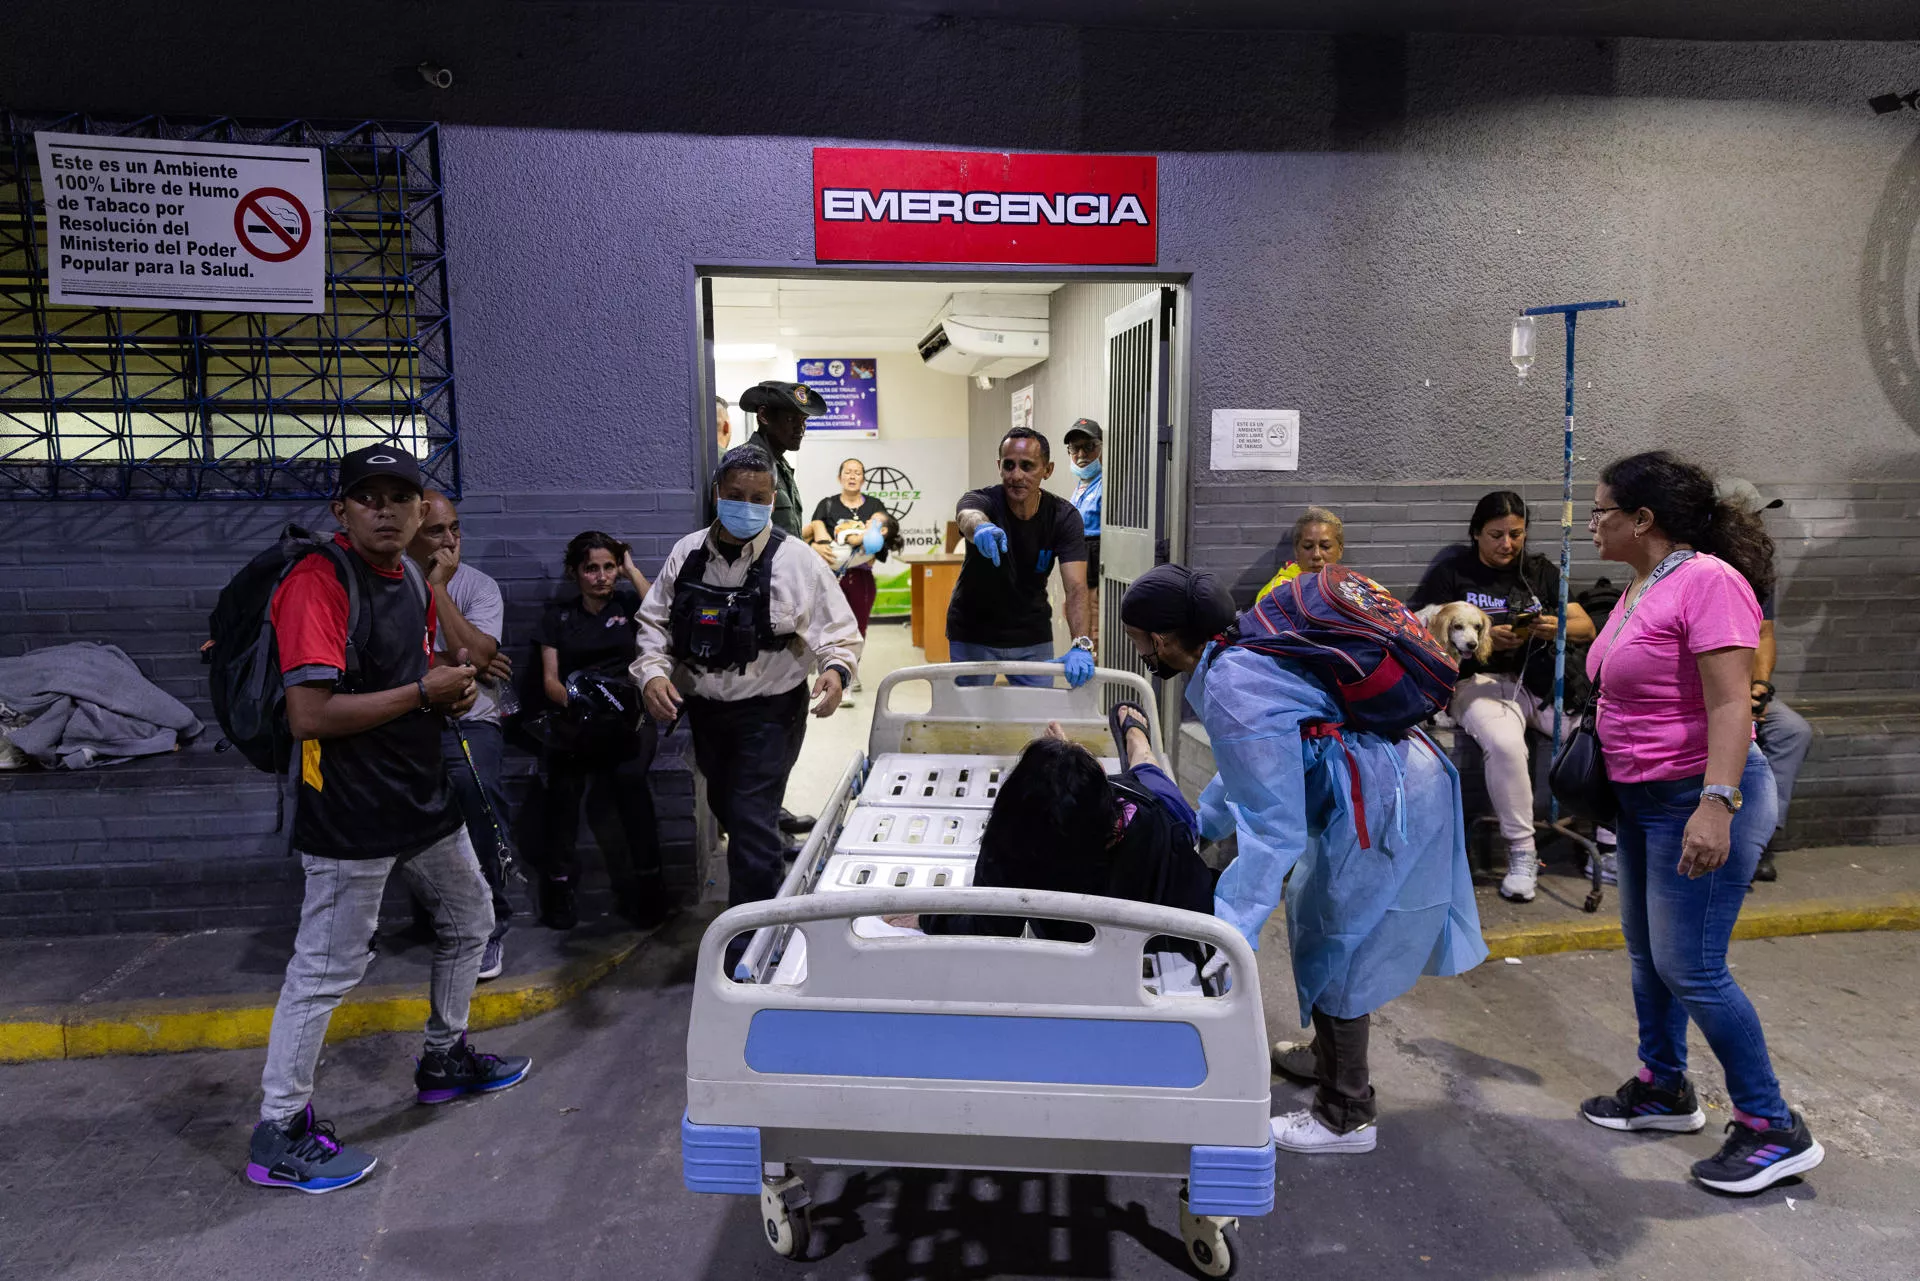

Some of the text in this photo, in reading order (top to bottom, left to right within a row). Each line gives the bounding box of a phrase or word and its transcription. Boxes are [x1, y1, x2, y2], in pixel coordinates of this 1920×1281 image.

[52, 153, 238, 179] Este es un Ambiente
[54, 174, 240, 199] 100% Libre de Humo
[57, 195, 185, 219] de Tabaco por
[822, 187, 1149, 226] EMERGENCIA
[59, 215, 190, 236] Resolución del
[60, 235, 237, 258] Ministerio del Poder
[61, 255, 255, 278] Popular para la Salud.
[906, 537, 942, 545] MORA
